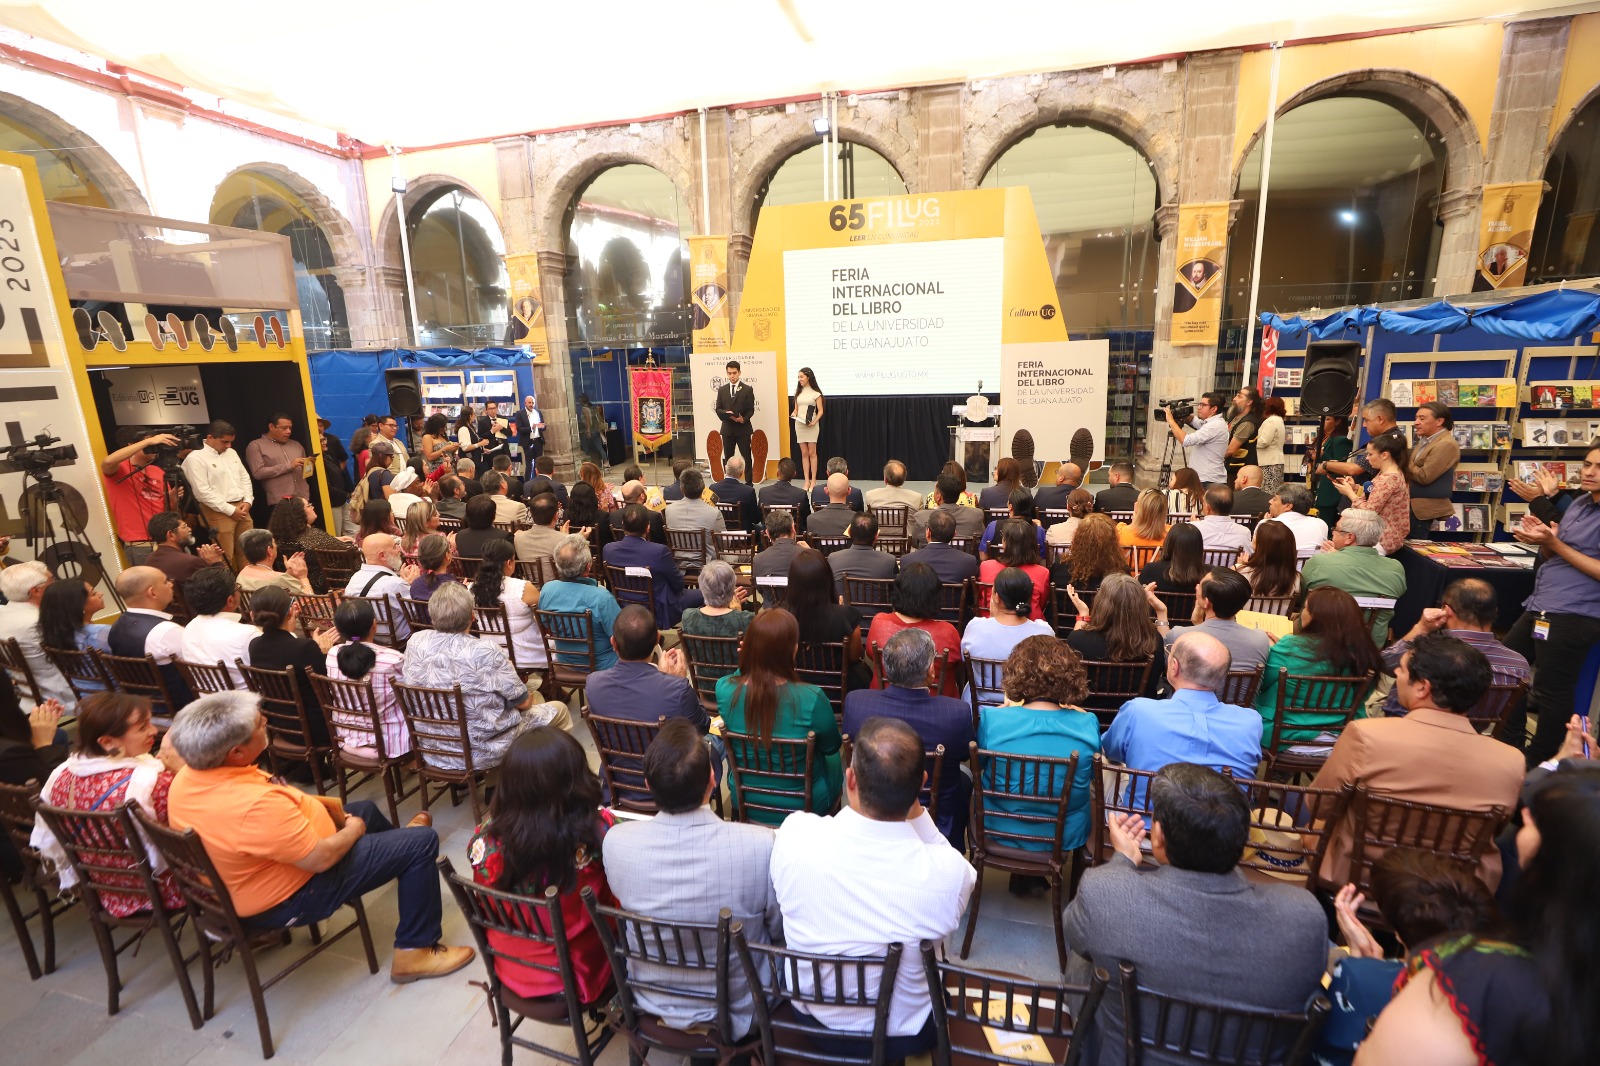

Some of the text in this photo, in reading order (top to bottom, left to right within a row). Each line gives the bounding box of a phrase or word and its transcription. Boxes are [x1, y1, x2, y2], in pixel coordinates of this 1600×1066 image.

[829, 203, 866, 232] 65
[849, 234, 866, 242] LEER
[0, 218, 32, 292] 2023
[832, 267, 869, 282] FERIA
[832, 281, 945, 299] INTERNACIONAL
[832, 300, 902, 316] DEL LIBRO
[1009, 307, 1055, 318] Cultura UG
[832, 317, 945, 333] DE LA UNIVERSIDAD
[833, 335, 929, 350] DE GUANAJUATO
[1017, 360, 1044, 369] FERIA
[1017, 368, 1094, 378] INTERNACIONAL
[1017, 378, 1065, 387] DEL LIBRO
[179, 391, 199, 406] UG
[1029, 388, 1040, 396] LA
[1041, 387, 1095, 395] UNIVERSIDAD
[1029, 396, 1083, 405] GUANAJUATO
